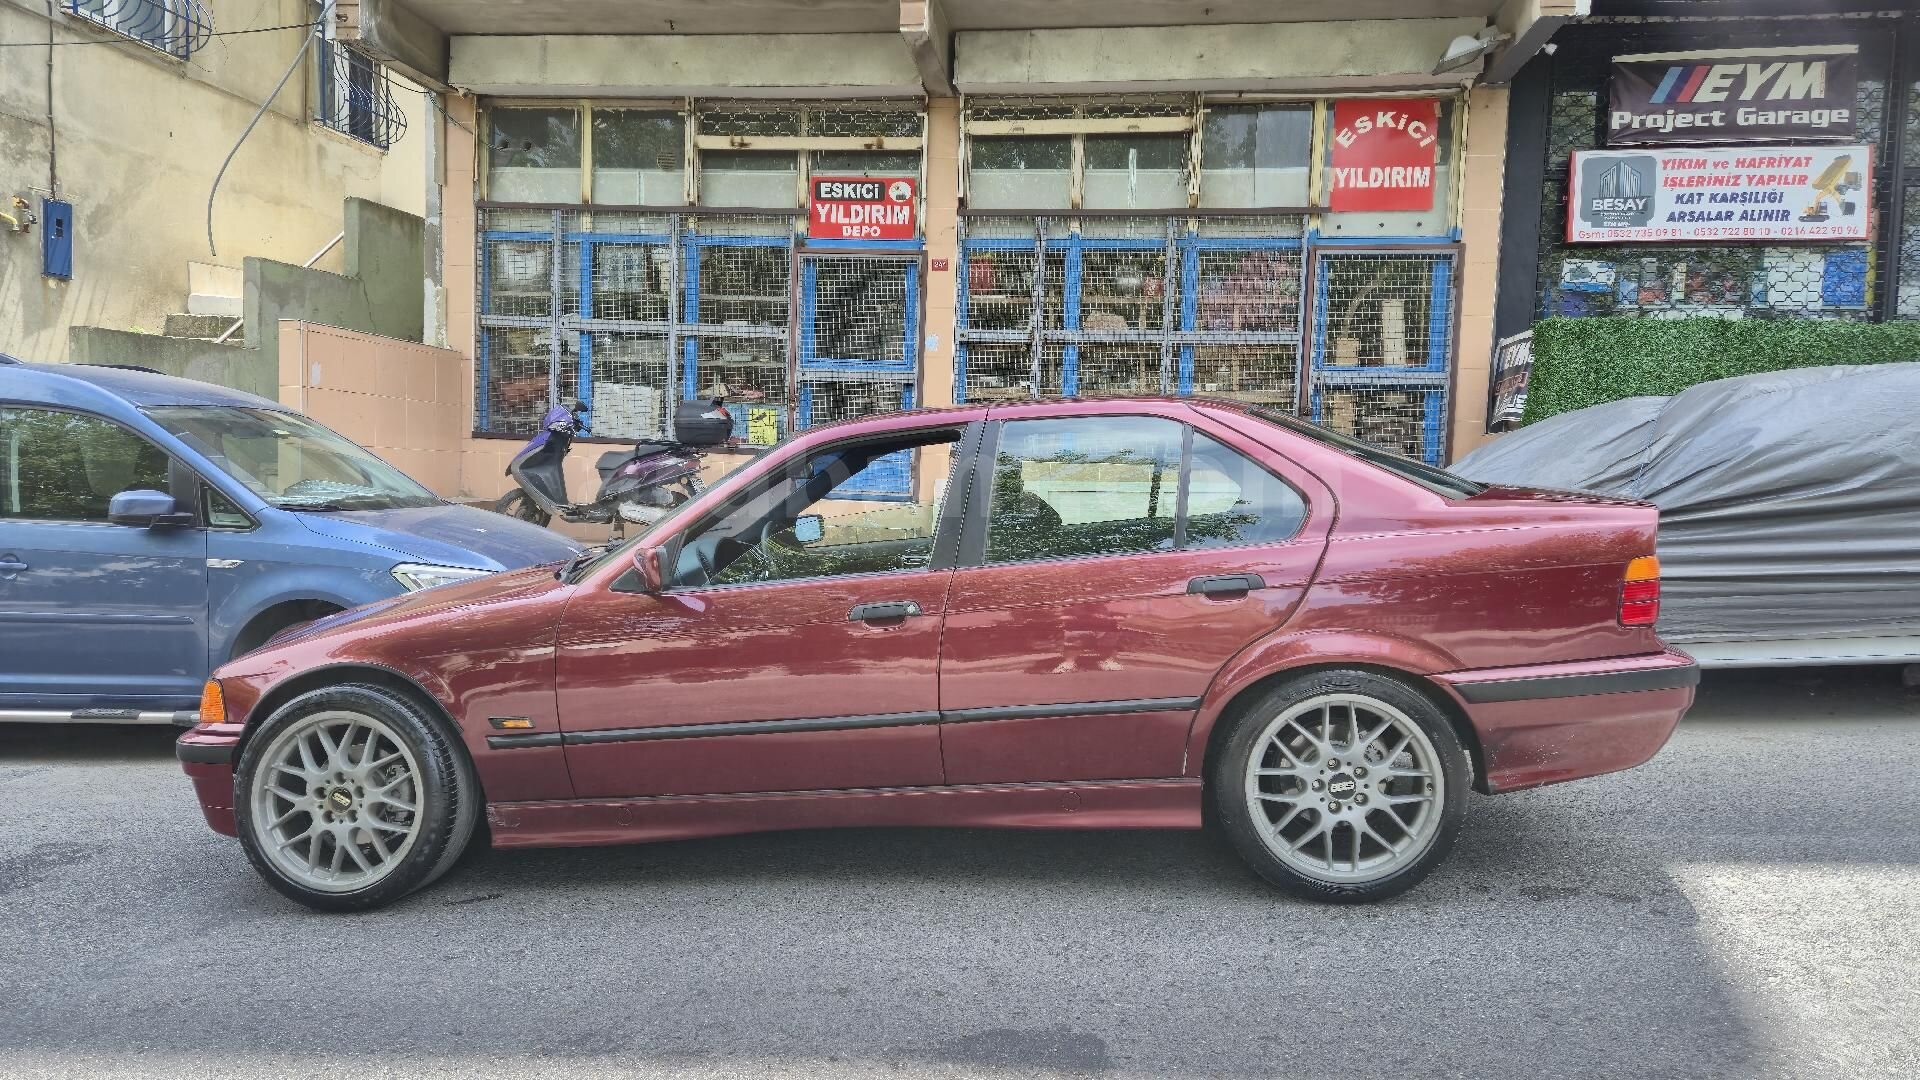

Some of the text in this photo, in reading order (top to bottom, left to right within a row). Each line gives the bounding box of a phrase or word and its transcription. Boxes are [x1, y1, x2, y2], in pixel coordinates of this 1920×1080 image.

[1691, 61, 1826, 103] EYM
[1611, 106, 1850, 133] Project Garage
[1661, 154, 1813, 171] YIKIM ve HAFRİYAT
[1335, 166, 1431, 188] YILDIRIM
[1663, 172, 1809, 191] İŞLERİNİZ YAPILIR
[1591, 198, 1647, 211] BESAY
[1674, 188, 1784, 206] KAT KARŞILIĞI
[815, 203, 910, 225] YILDIRIM
[1665, 209, 1791, 223] ARSALAR ALINIR
[842, 225, 881, 237] DEPO
[1578, 230, 1606, 239] Gsm:
[1607, 228, 1632, 238] 0532
[1655, 227, 1668, 237] 09
[1693, 227, 1719, 237] 0532
[1721, 227, 1740, 236] 722
